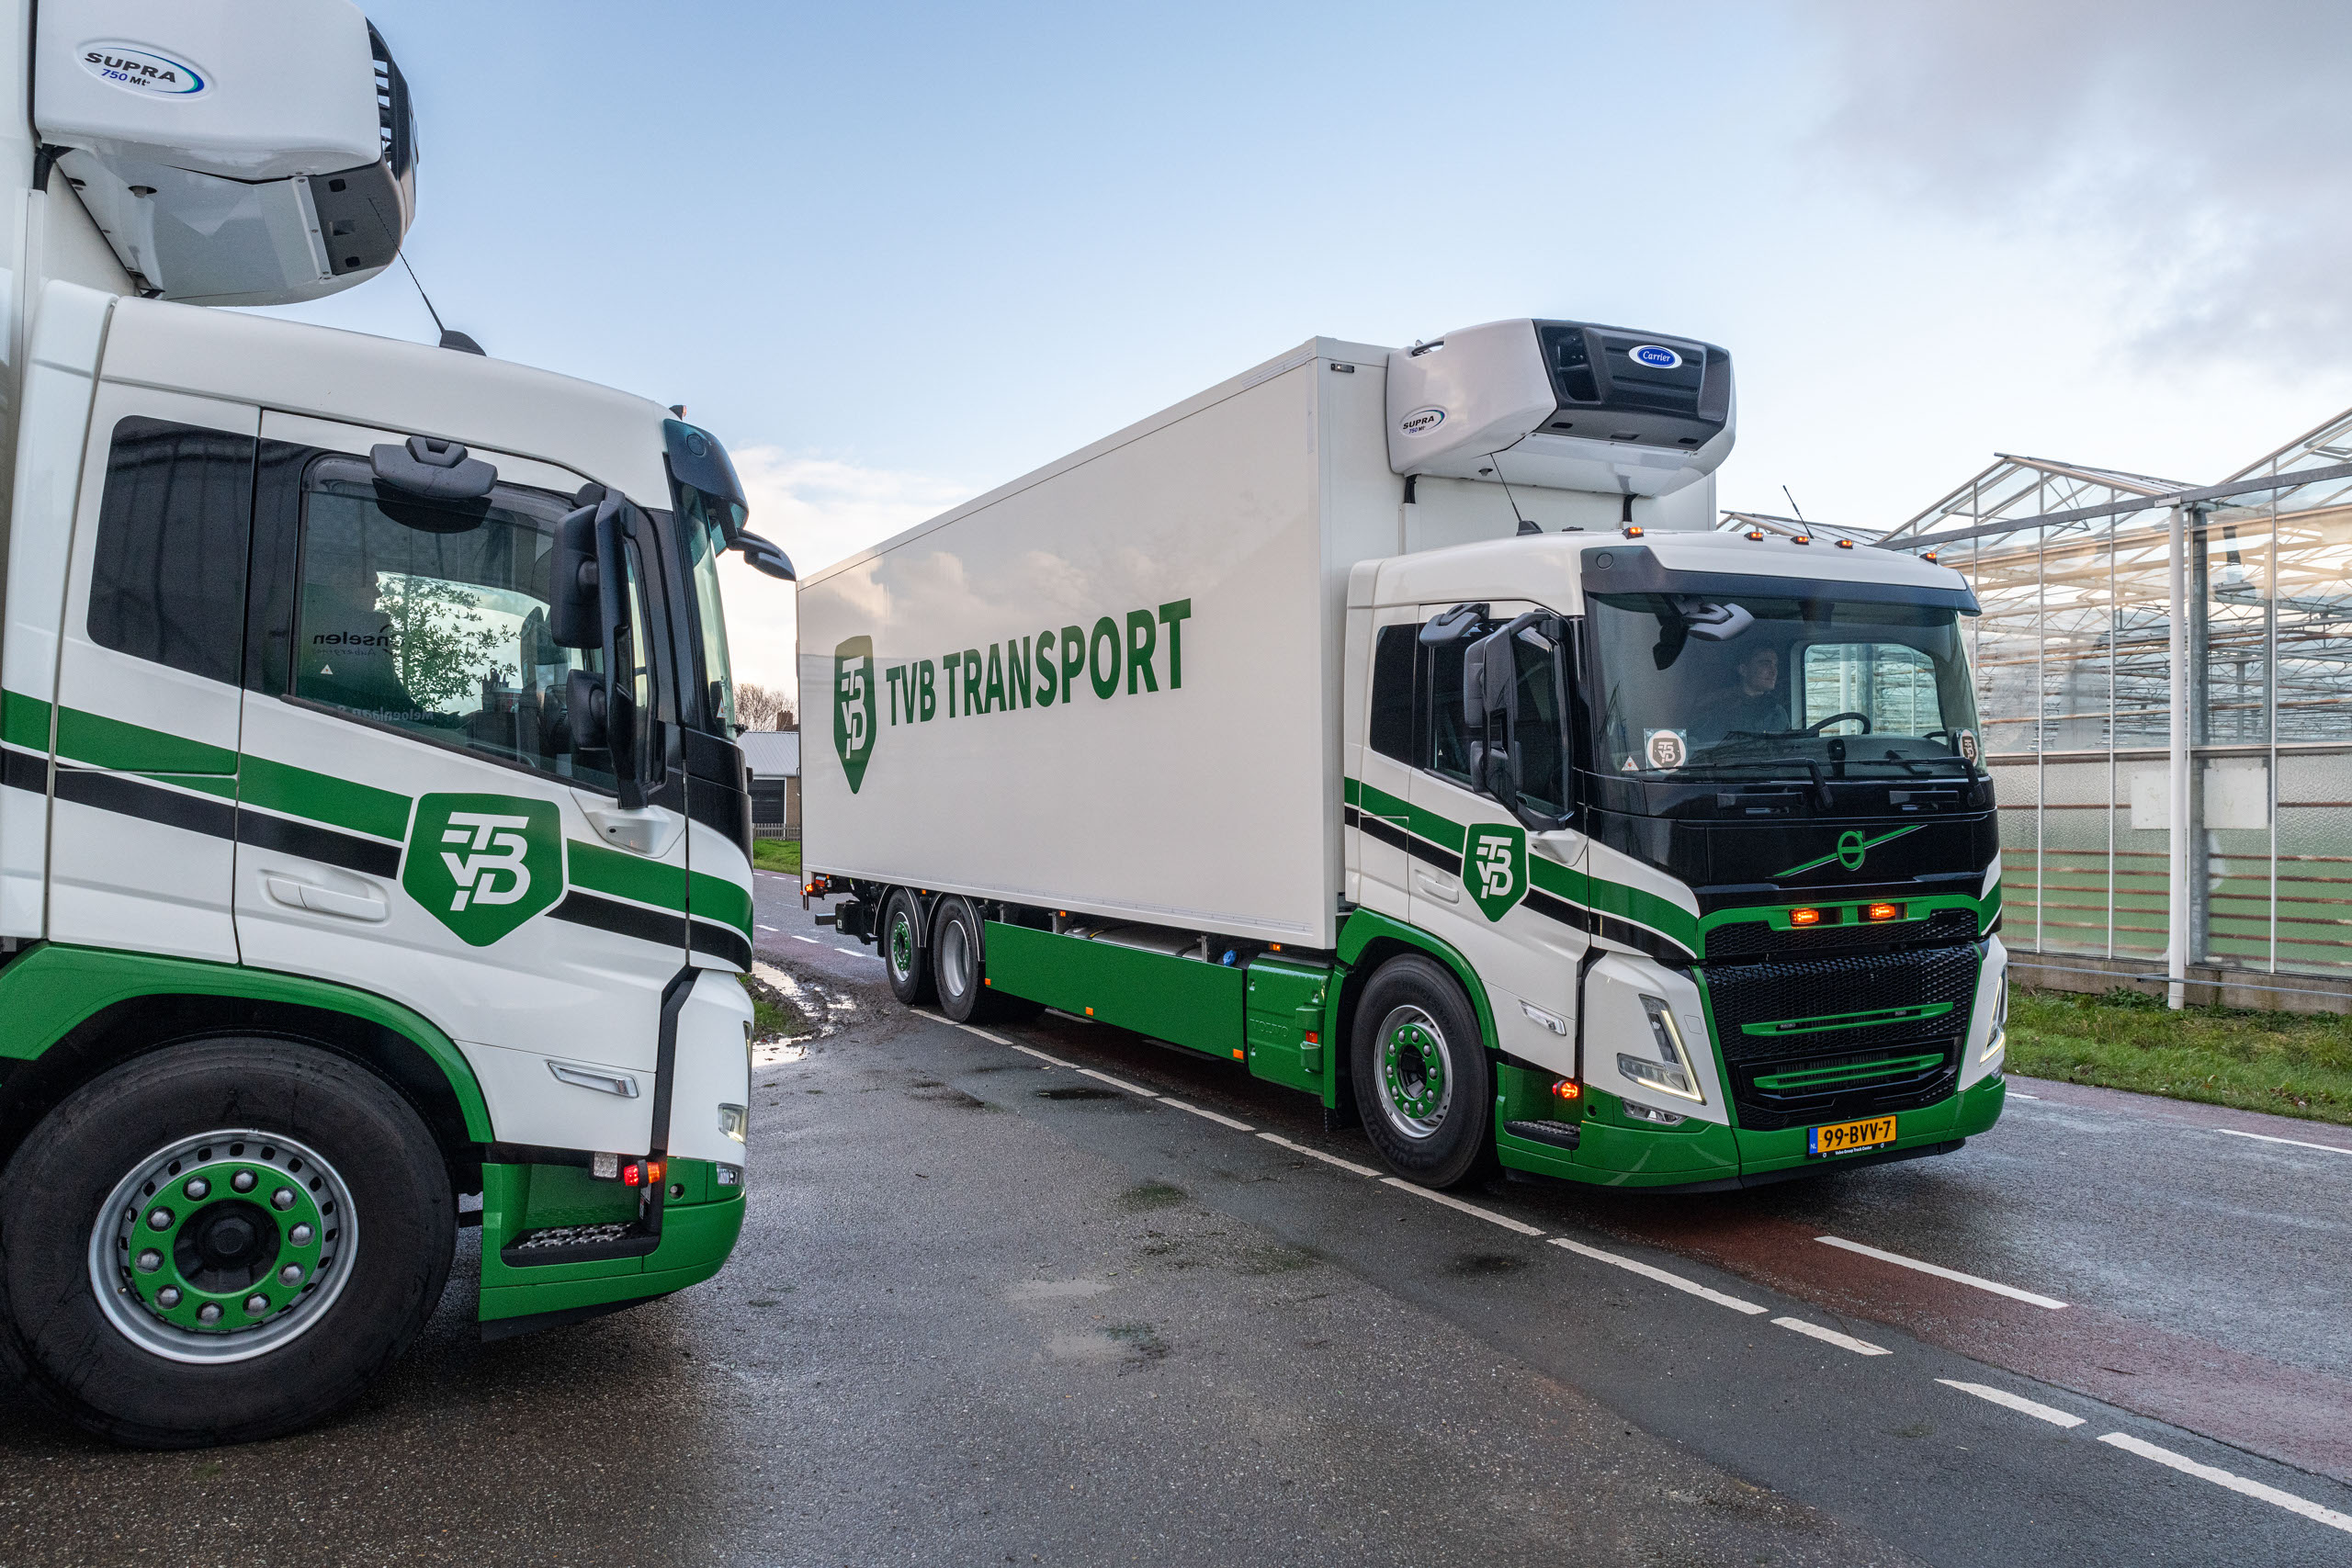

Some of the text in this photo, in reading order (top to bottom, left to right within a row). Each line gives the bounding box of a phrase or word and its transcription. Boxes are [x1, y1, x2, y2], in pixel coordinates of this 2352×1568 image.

[85, 52, 176, 83] SUPRA
[101, 69, 128, 81] 750
[1643, 351, 1670, 362] Carrier
[1403, 416, 1434, 430] SUPRA
[886, 598, 1192, 727] TVB TRANSPORT
[1824, 1120, 1891, 1148] 99-BVV-7
